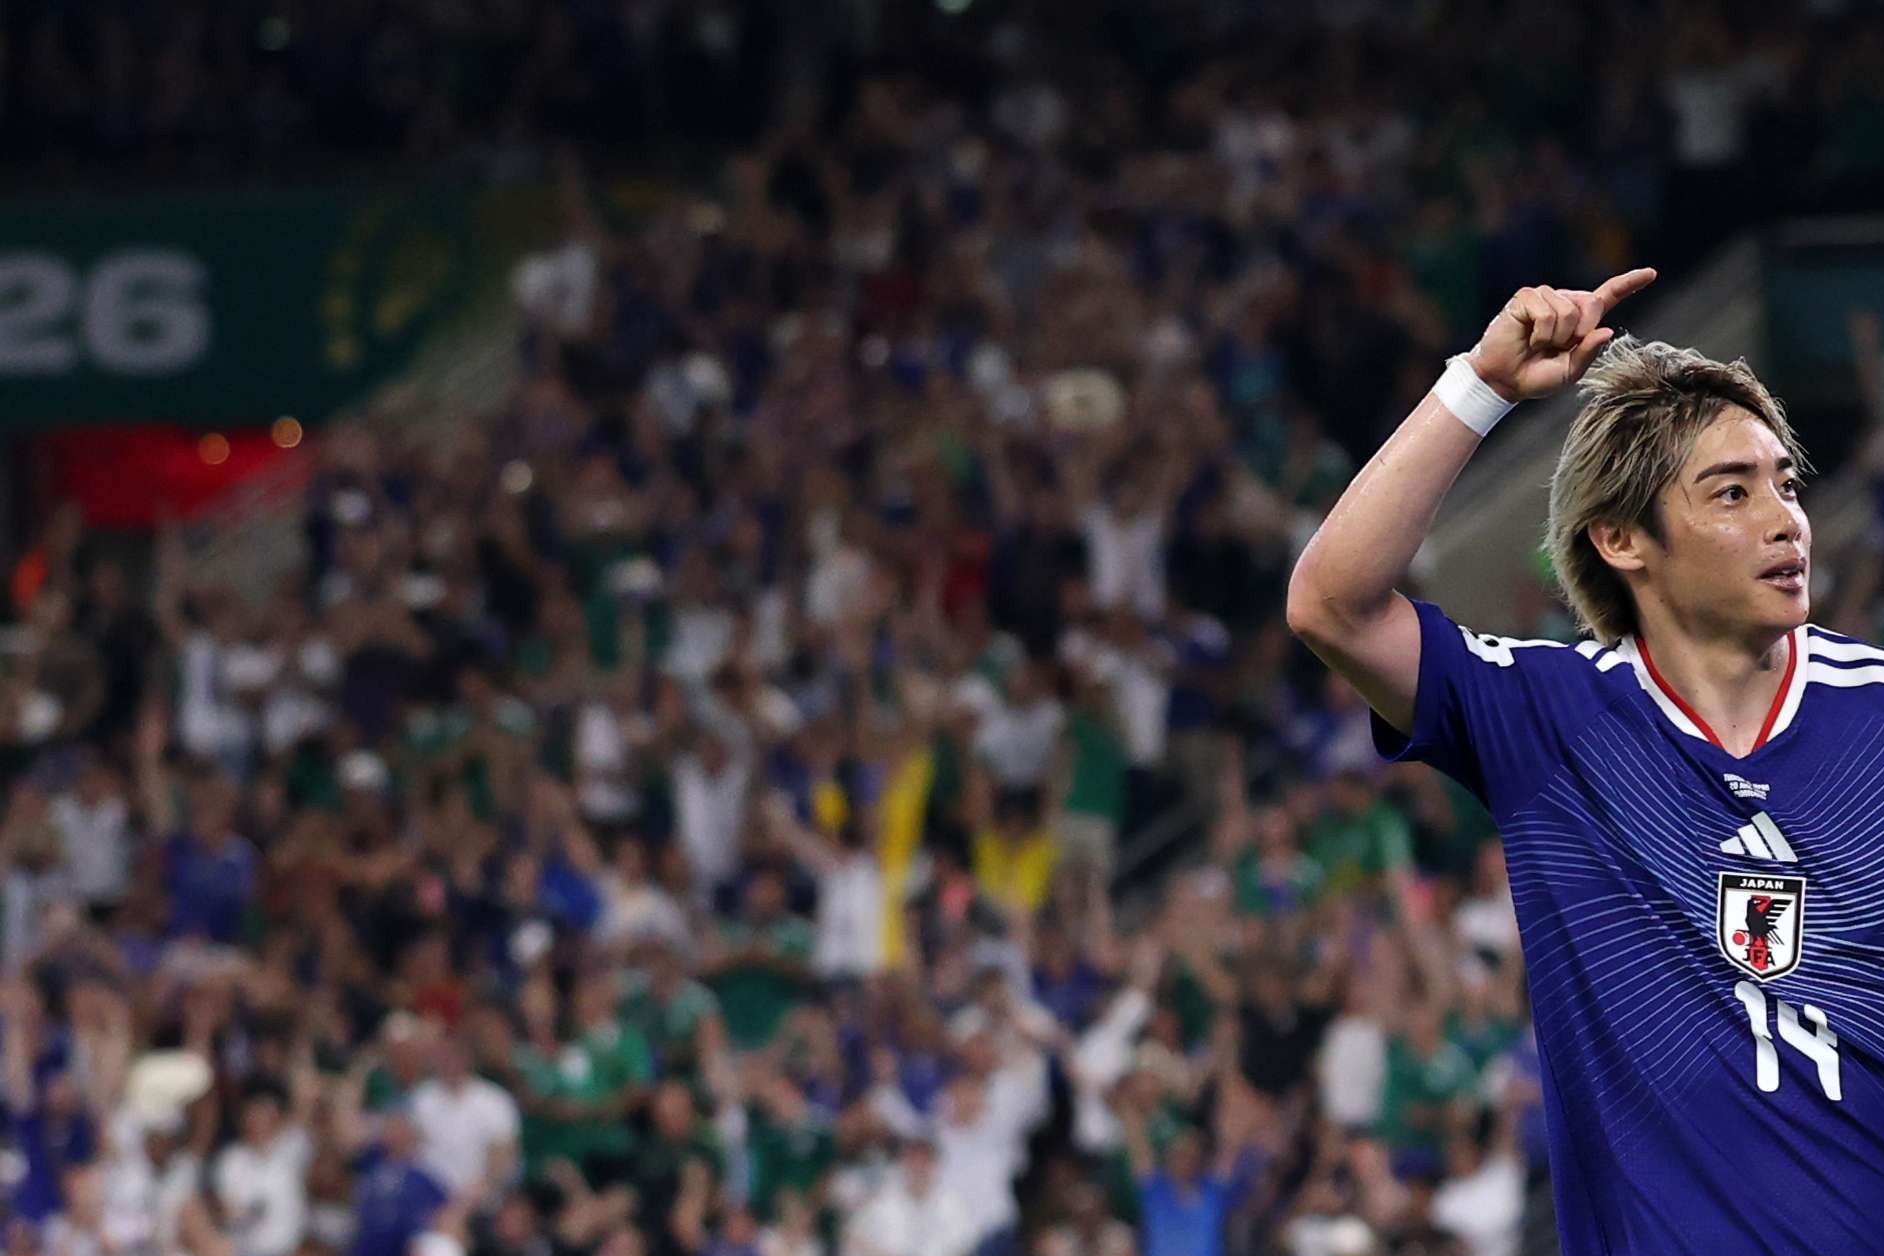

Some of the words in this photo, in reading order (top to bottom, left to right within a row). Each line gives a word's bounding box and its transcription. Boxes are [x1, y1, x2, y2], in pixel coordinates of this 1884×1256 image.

[1739, 877, 1784, 890] JAPAN
[1742, 948, 1776, 967] JFA
[1734, 980, 1842, 1101] 14
